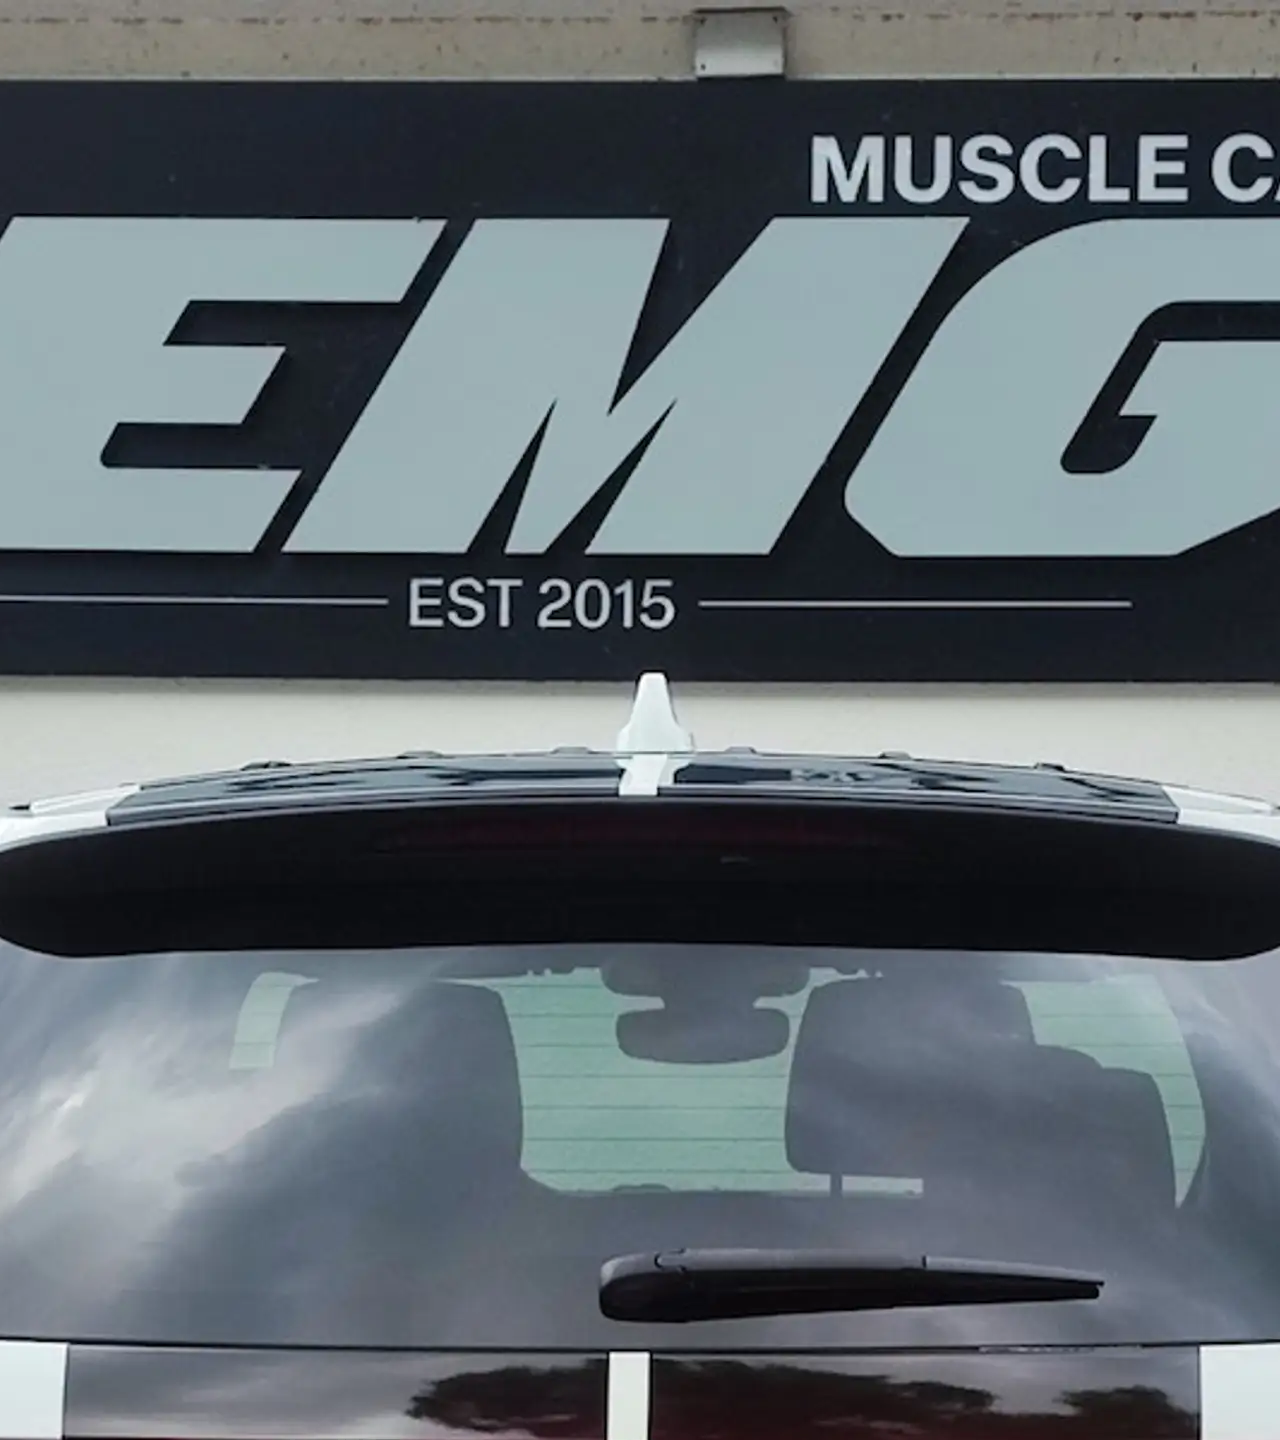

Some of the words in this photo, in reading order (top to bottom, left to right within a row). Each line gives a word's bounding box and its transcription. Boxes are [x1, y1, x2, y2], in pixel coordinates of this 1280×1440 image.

[810, 133, 1189, 204] MUSCLE
[408, 577, 524, 629] EST
[537, 577, 676, 630] 2015
